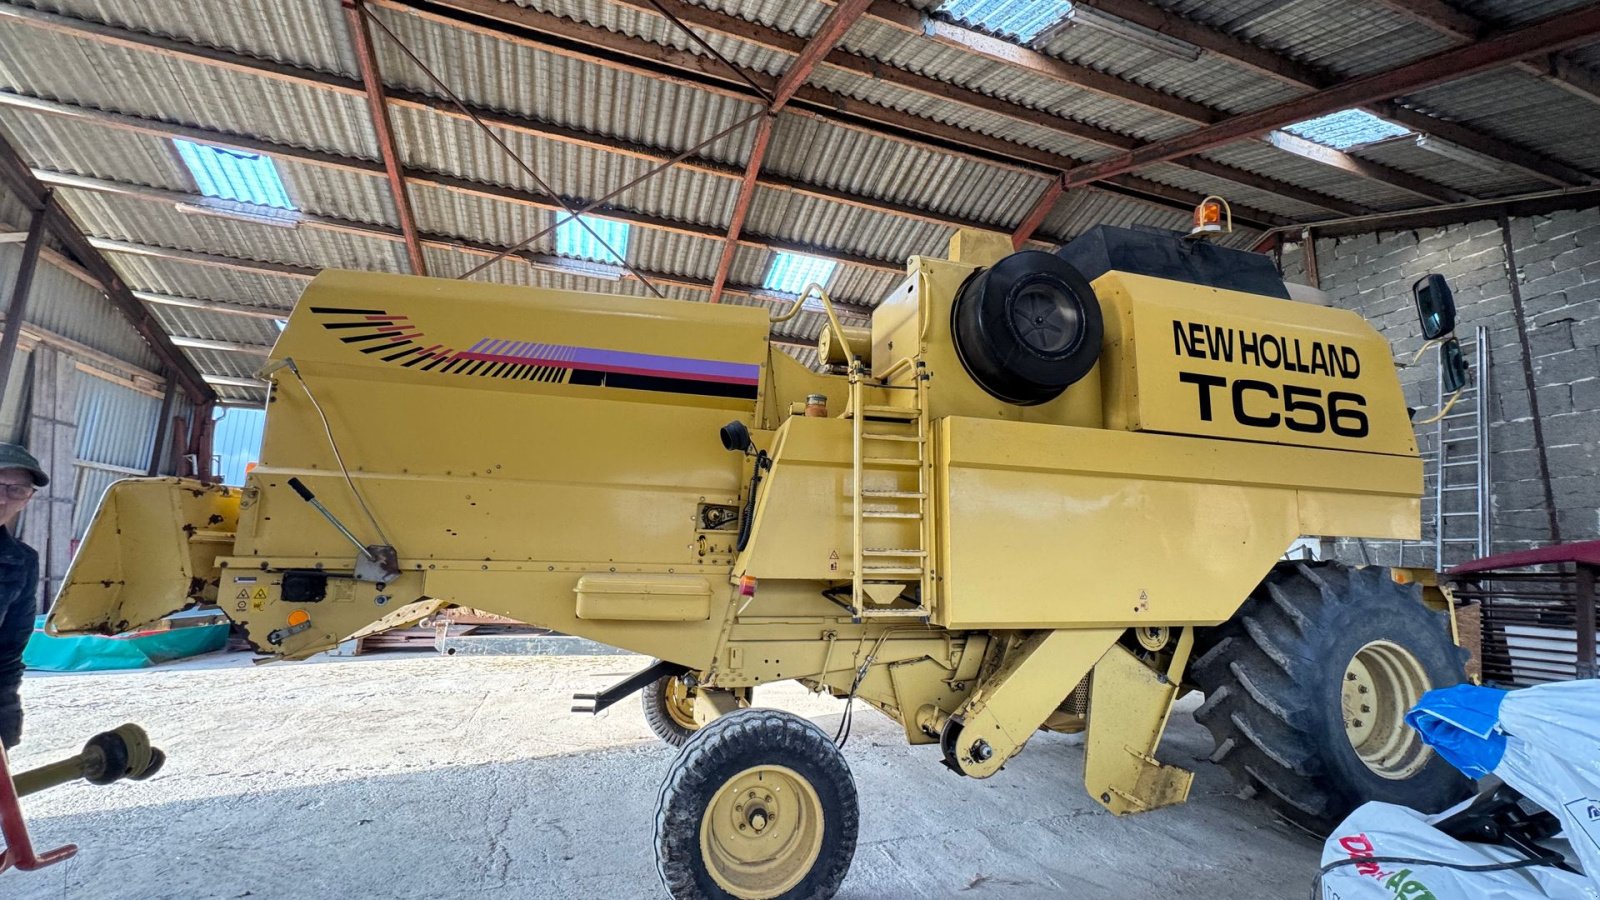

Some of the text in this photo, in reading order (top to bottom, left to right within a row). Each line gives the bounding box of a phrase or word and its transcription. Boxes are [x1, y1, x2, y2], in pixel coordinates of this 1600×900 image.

[1173, 320, 1360, 379] NEW HOLLAND
[1179, 371, 1369, 438] TC56
